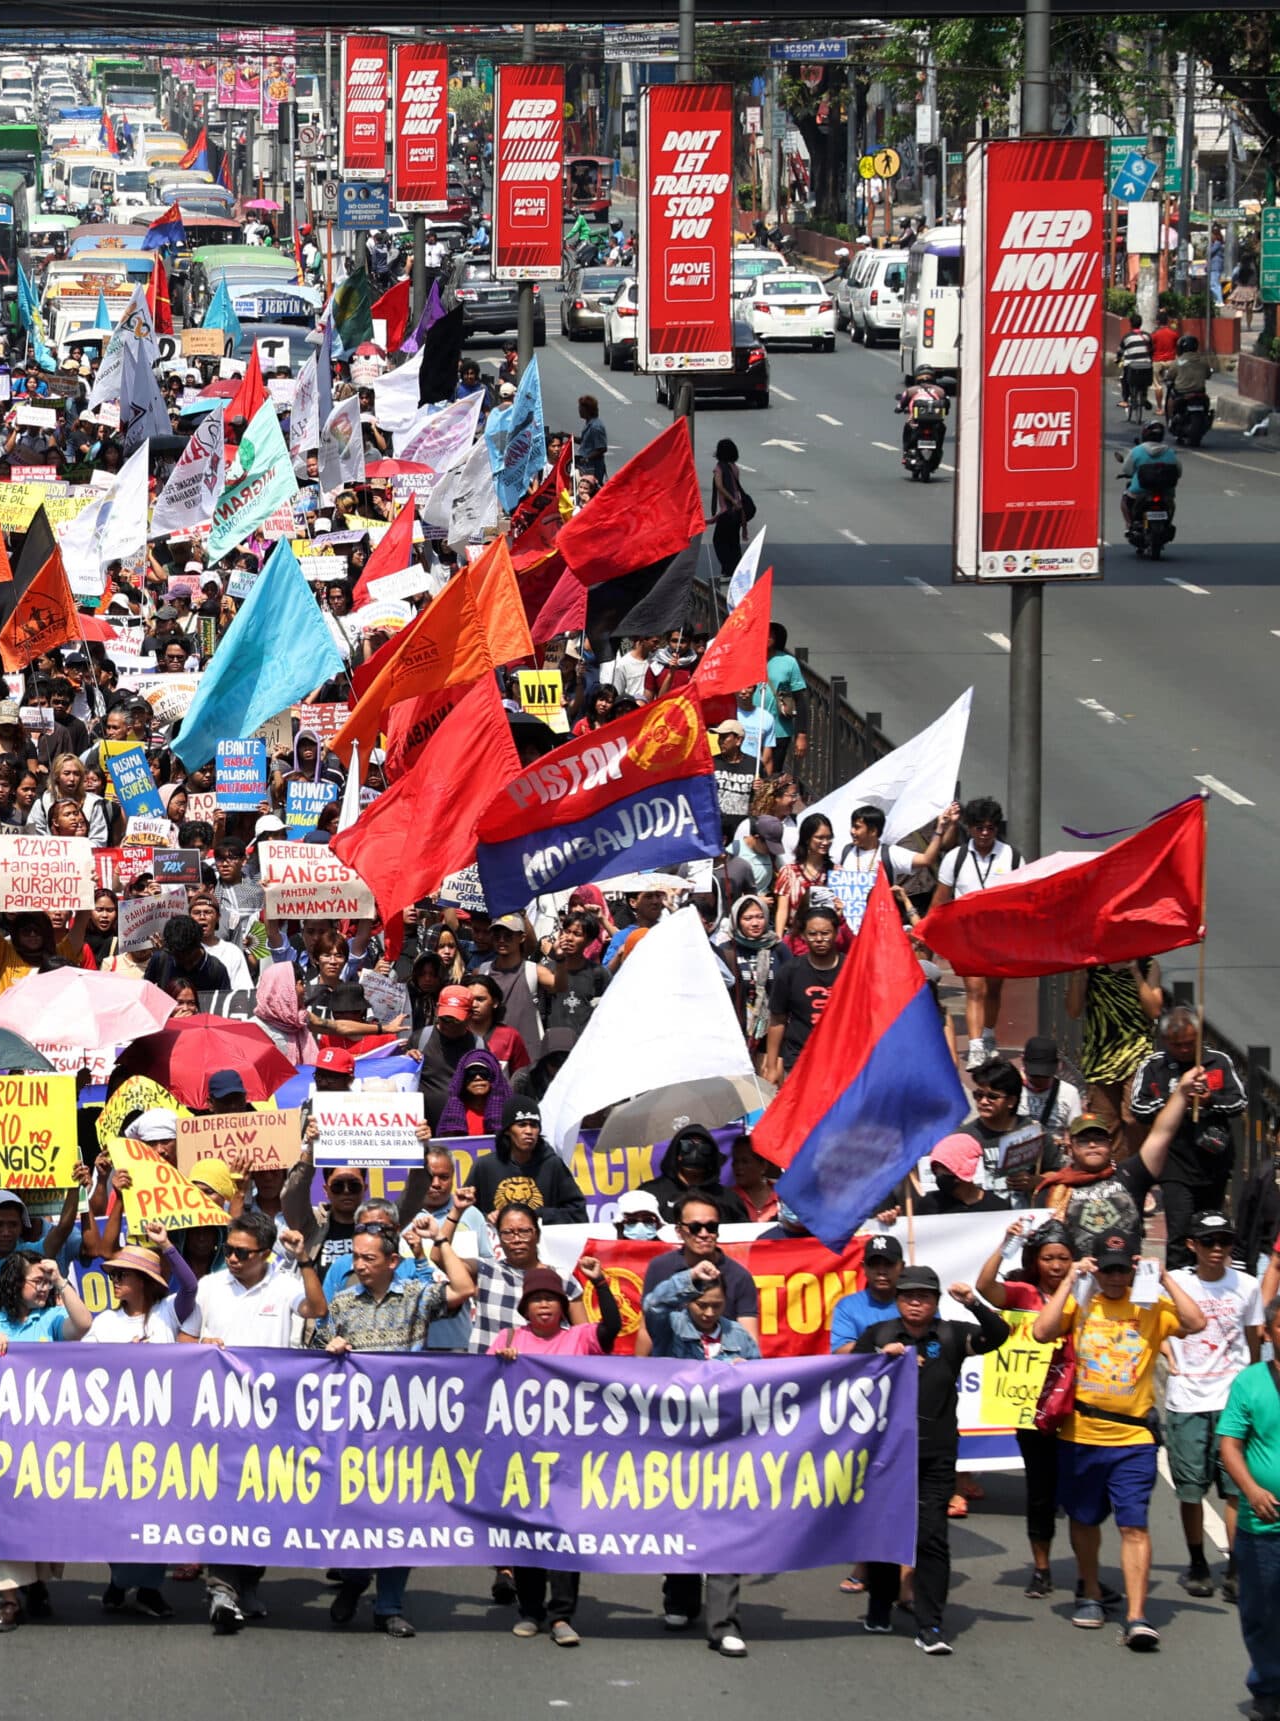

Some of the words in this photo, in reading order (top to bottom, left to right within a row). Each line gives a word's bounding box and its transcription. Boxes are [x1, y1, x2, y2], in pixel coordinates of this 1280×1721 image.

[818, 42, 841, 53] Ave
[351, 58, 384, 72] KEEP
[405, 70, 440, 86] LIFE
[400, 87, 443, 103] DOES
[405, 102, 440, 119] NOT
[507, 99, 558, 119] KEEP
[401, 118, 443, 136] WAIT
[662, 130, 722, 152] DON'T
[672, 152, 710, 174] LET
[652, 174, 729, 196] TRAFFIC
[514, 198, 546, 208] MOVE
[664, 196, 714, 218] STOP
[670, 218, 713, 240] YOU
[1000, 209, 1093, 249] KEEP
[670, 262, 710, 274] MOVE
[1013, 411, 1071, 430] MOVE
[524, 684, 558, 704] VAT
[218, 740, 260, 755] ABANTE
[216, 769, 260, 780] PALABAN
[506, 736, 628, 809] PISTON
[289, 782, 334, 799] BUWIS
[122, 850, 146, 858] DEATH
[162, 862, 185, 873] TAX
[324, 1050, 334, 1062] B
[180, 1120, 201, 1134] OIL
[202, 1114, 288, 1132] DEREGULATION
[320, 1112, 420, 1128] WAKASAN
[28, 1129, 53, 1151] ng
[212, 1130, 258, 1150] LAW
[334, 1138, 380, 1147] US-ISRAEL
[338, 1130, 374, 1138] GERANG
[5, 1173, 58, 1189] MUNA
[192, 1369, 278, 1430] ANG
[296, 1371, 464, 1434] GERANG
[484, 1376, 720, 1438] AGRESYON
[740, 1382, 802, 1436] NG
[818, 1374, 893, 1436] US!
[236, 1444, 322, 1505] ANG
[340, 1445, 483, 1506] BUHAY
[501, 1450, 560, 1510] AT
[580, 1448, 870, 1510] KABUHAYAN!
[130, 1524, 272, 1547] -BAGONG
[283, 1526, 475, 1550] ALYANSANG
[488, 1530, 698, 1556] MAKABAYAN-
